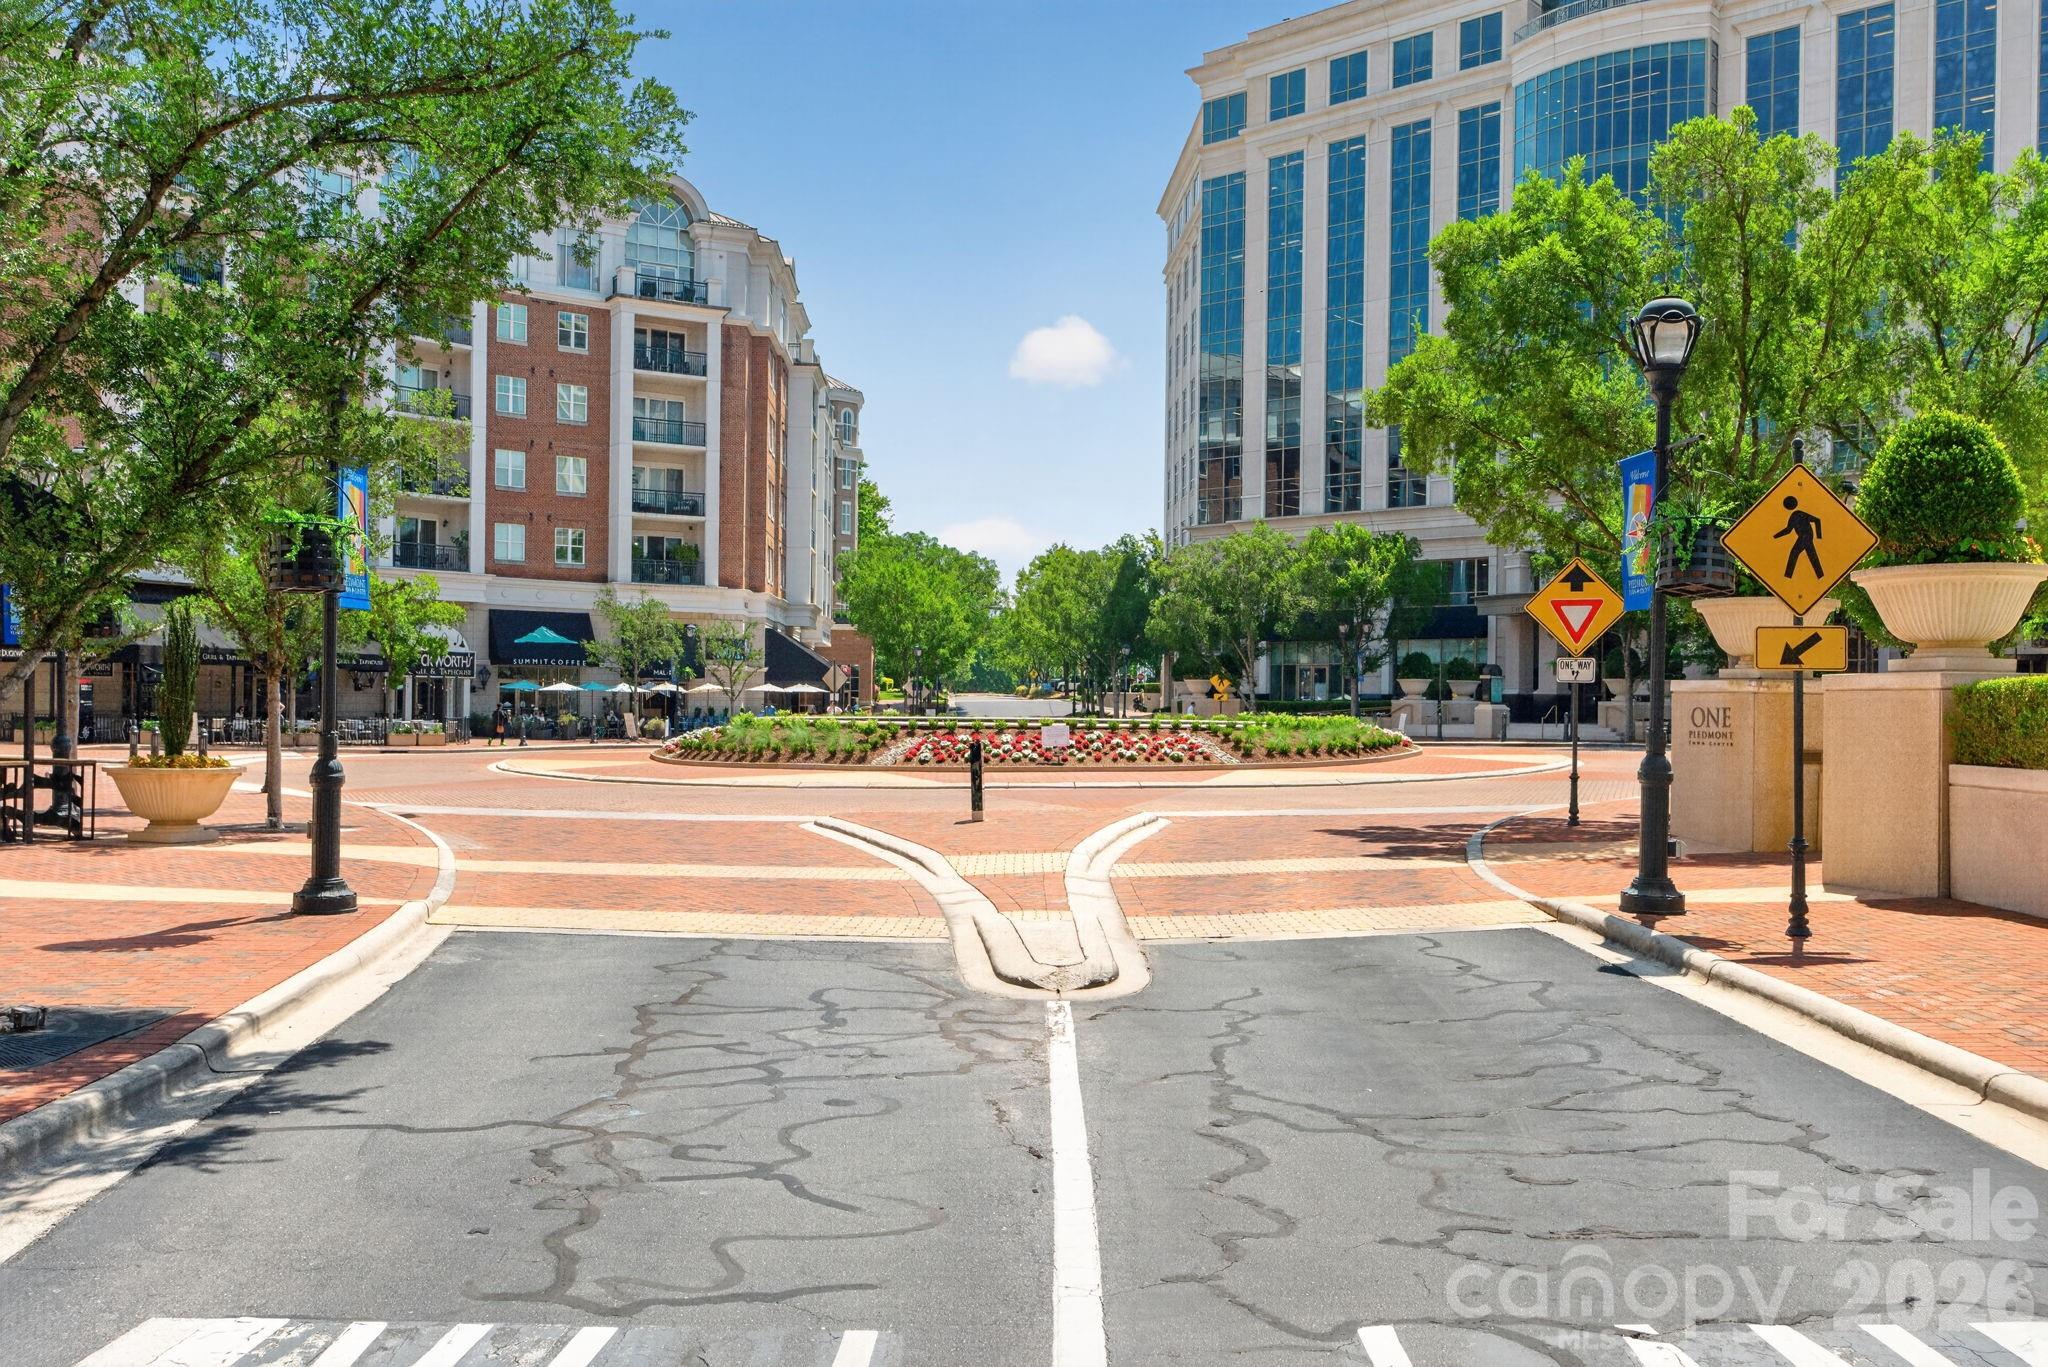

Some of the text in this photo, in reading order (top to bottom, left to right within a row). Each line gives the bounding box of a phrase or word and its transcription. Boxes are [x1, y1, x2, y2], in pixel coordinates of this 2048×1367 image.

[1560, 660, 1592, 670] ONE WAY
[1690, 706, 1731, 728] ONE
[1689, 730, 1734, 740] PIEDMONT
